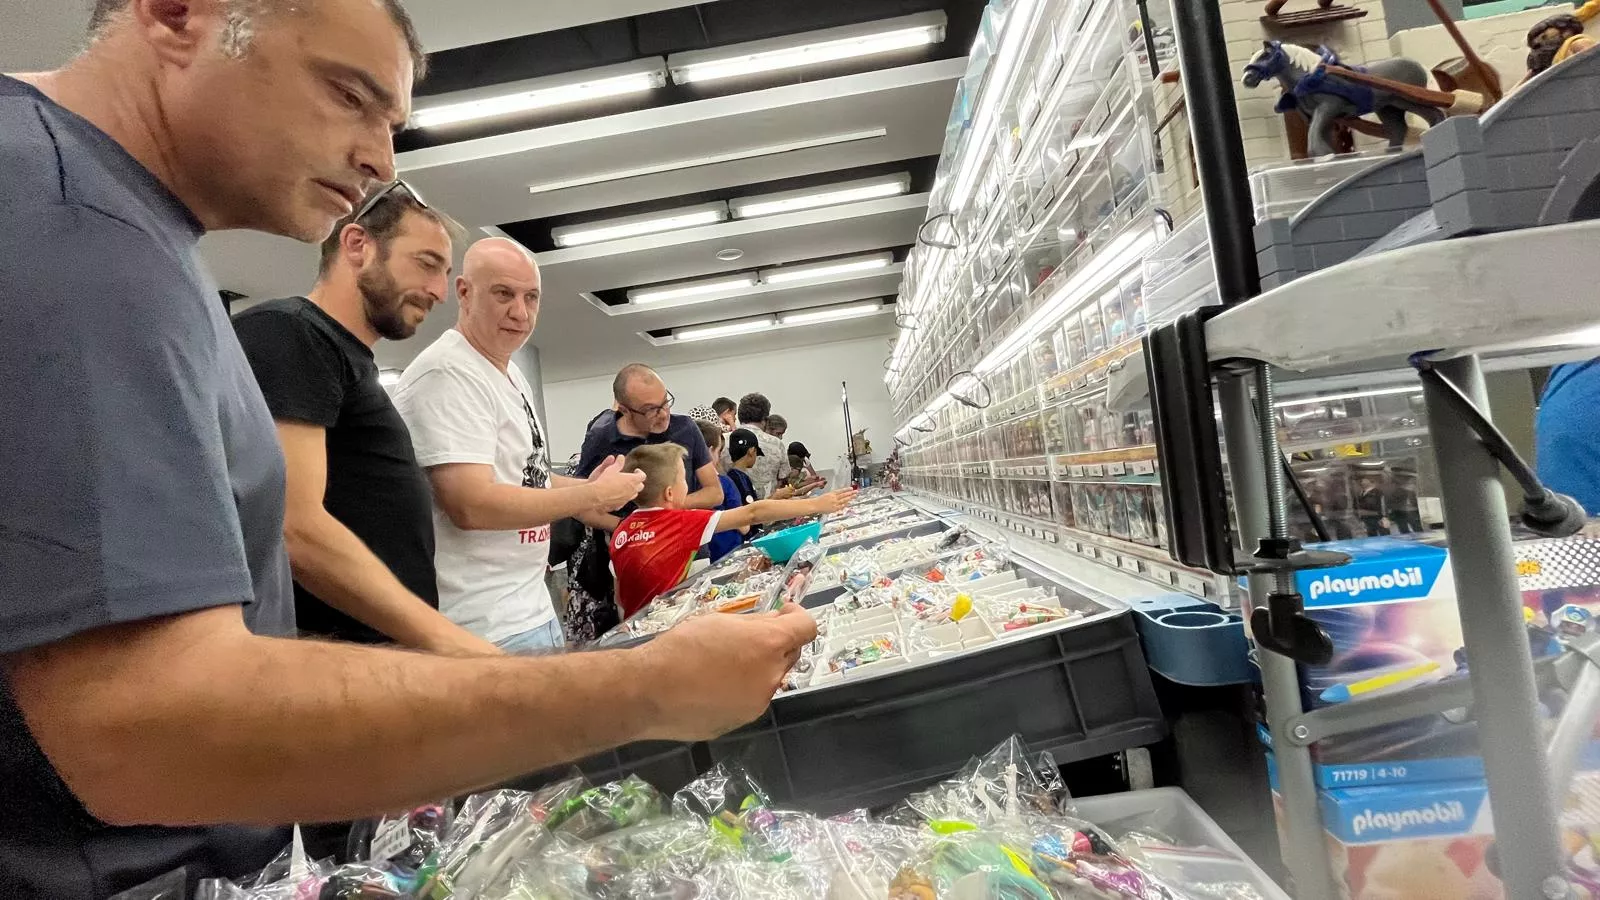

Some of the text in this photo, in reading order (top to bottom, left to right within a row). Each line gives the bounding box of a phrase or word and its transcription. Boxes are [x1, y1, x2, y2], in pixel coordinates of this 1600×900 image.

[1309, 566, 1424, 600] playmobil
[1332, 766, 1407, 782] 71719 4-10
[1352, 800, 1465, 836] playmobil
